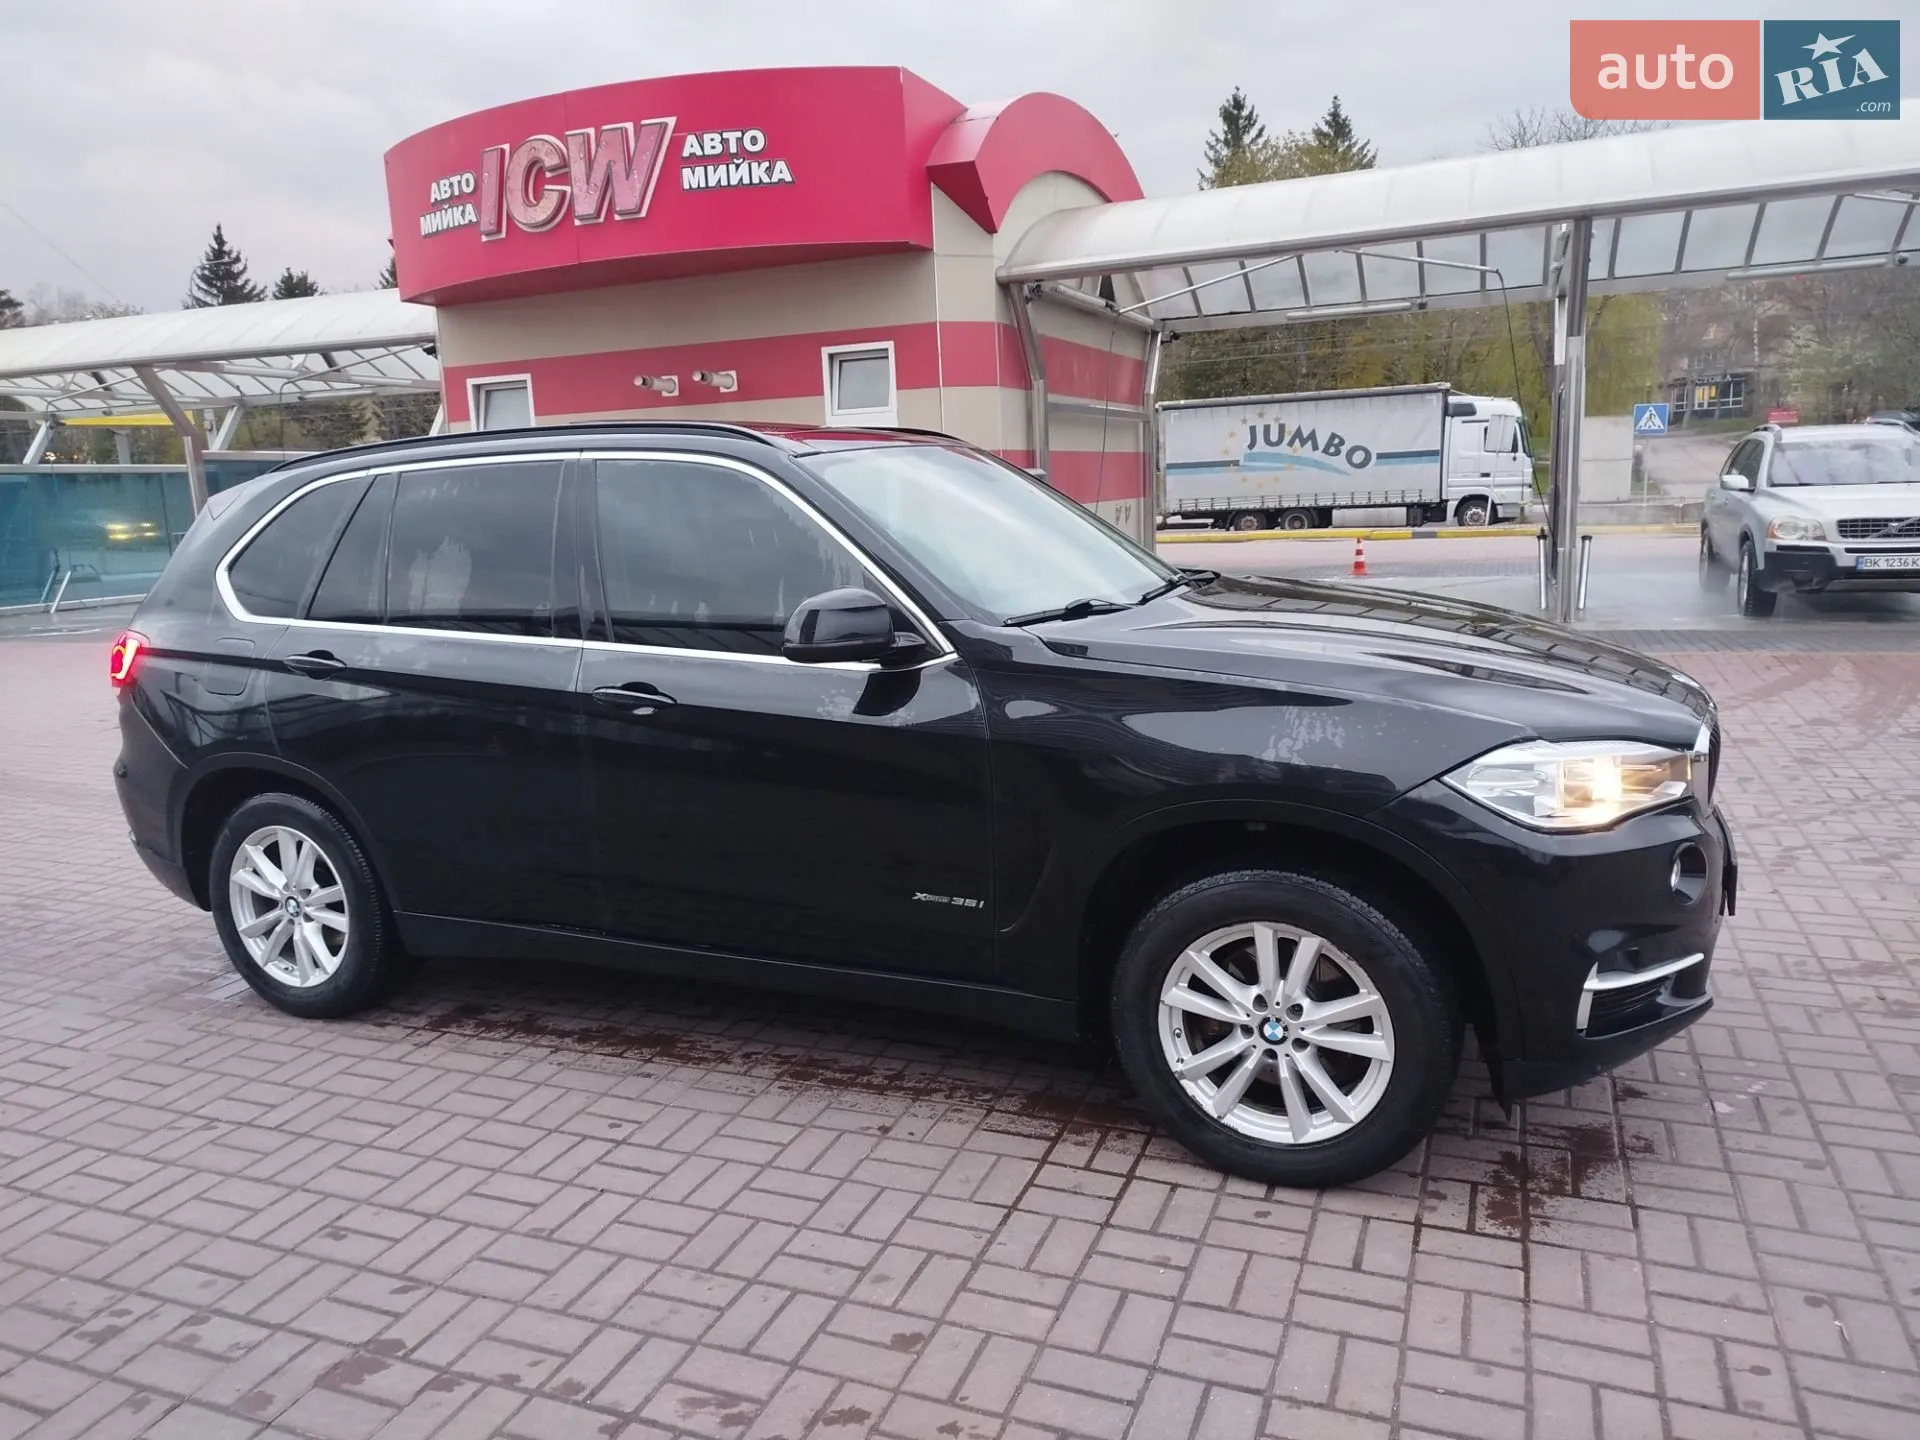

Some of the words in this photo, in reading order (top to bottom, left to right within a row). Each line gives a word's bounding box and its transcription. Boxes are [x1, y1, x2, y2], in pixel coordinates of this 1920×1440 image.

[682, 128, 766, 158] АВТО
[430, 171, 475, 203] АВТО
[480, 116, 677, 242] ICW
[681, 158, 794, 190] МИЙКА
[420, 203, 478, 237] МИЙКА
[1247, 422, 1373, 469] JUMBO
[1884, 557, 1910, 568] 1236
